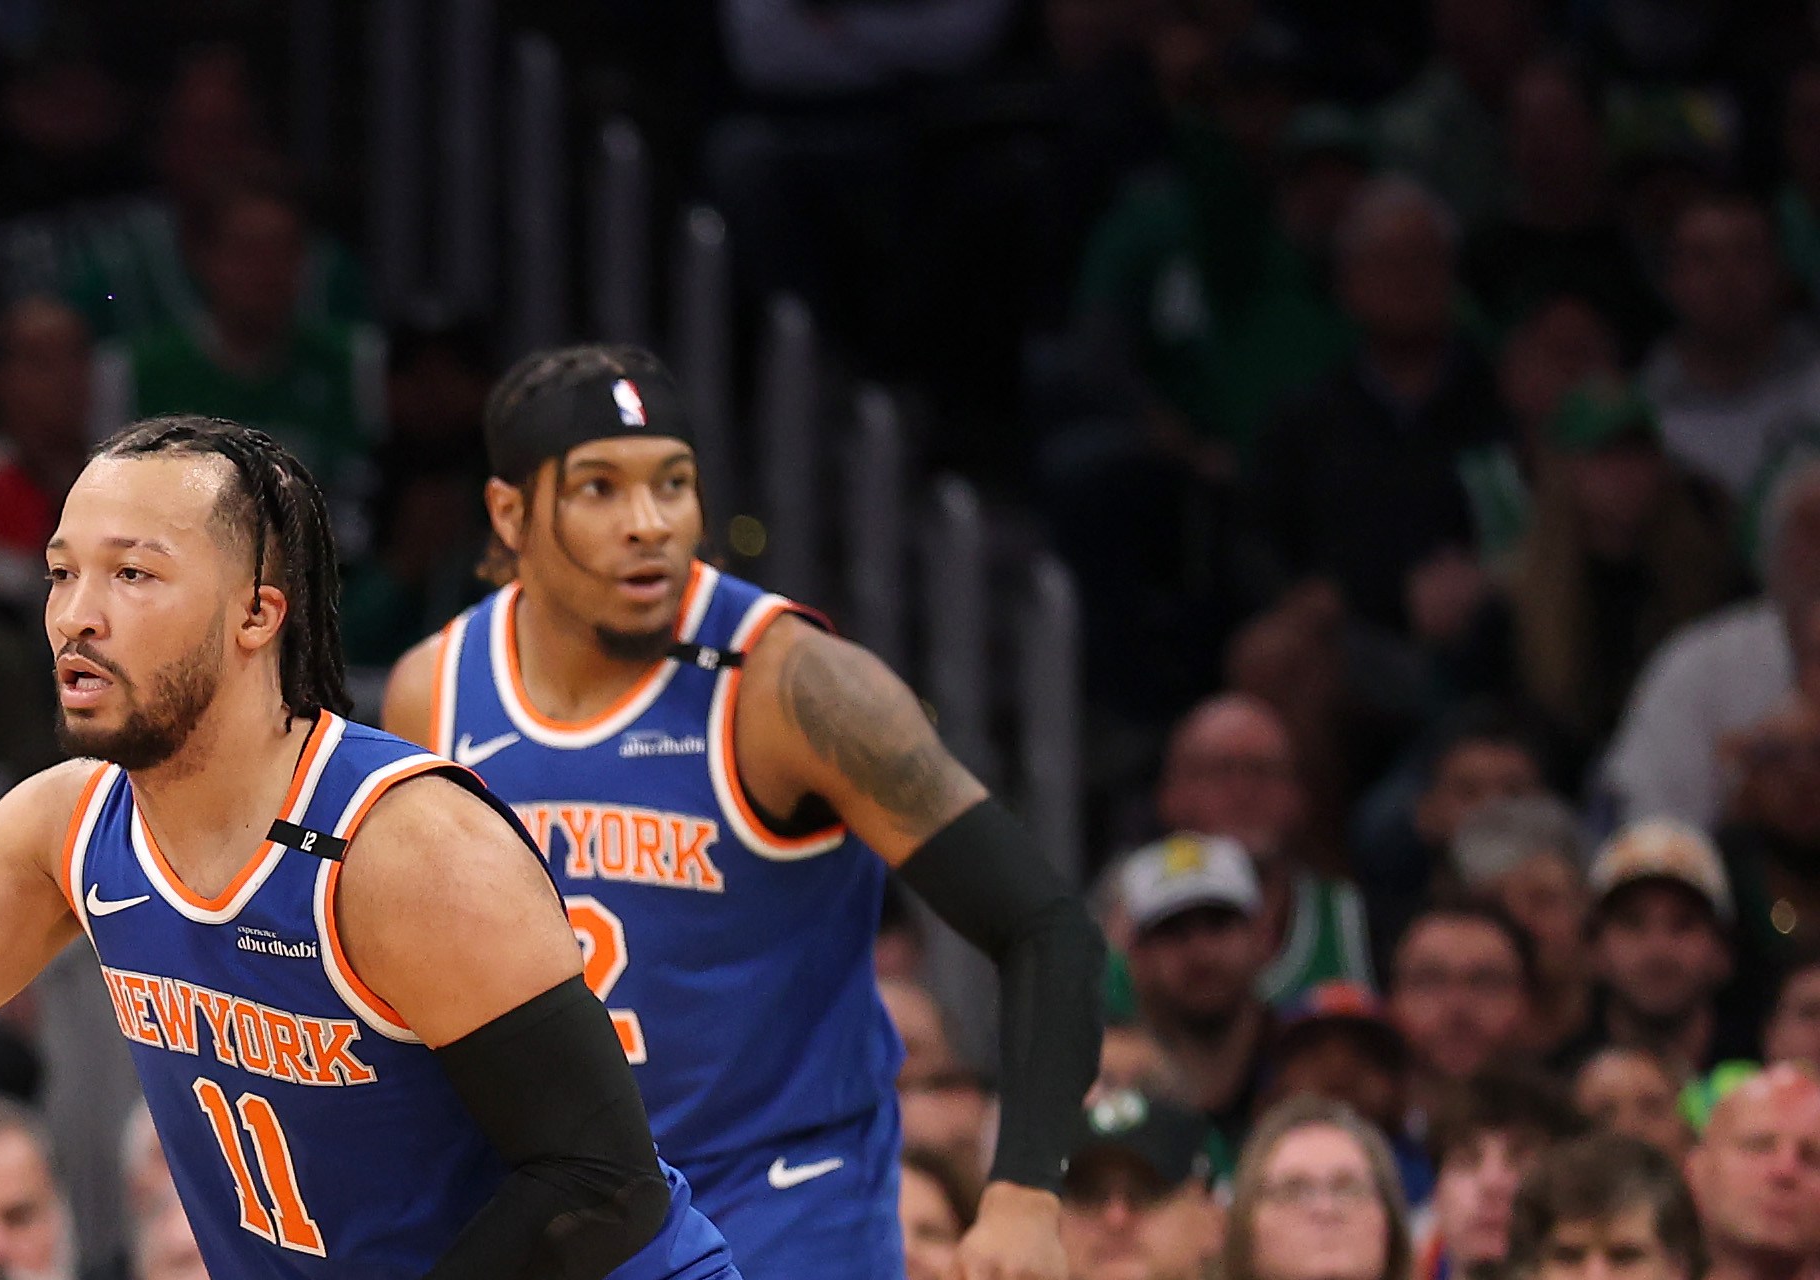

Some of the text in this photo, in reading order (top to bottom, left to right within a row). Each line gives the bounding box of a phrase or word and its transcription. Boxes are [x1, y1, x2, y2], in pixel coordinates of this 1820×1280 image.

[300, 831, 318, 852] 12
[558, 803, 725, 893] YORK
[237, 925, 277, 939] experience
[237, 935, 318, 959] abu dhabi
[101, 964, 379, 1087] NEW YORK
[192, 1076, 327, 1259] 11
